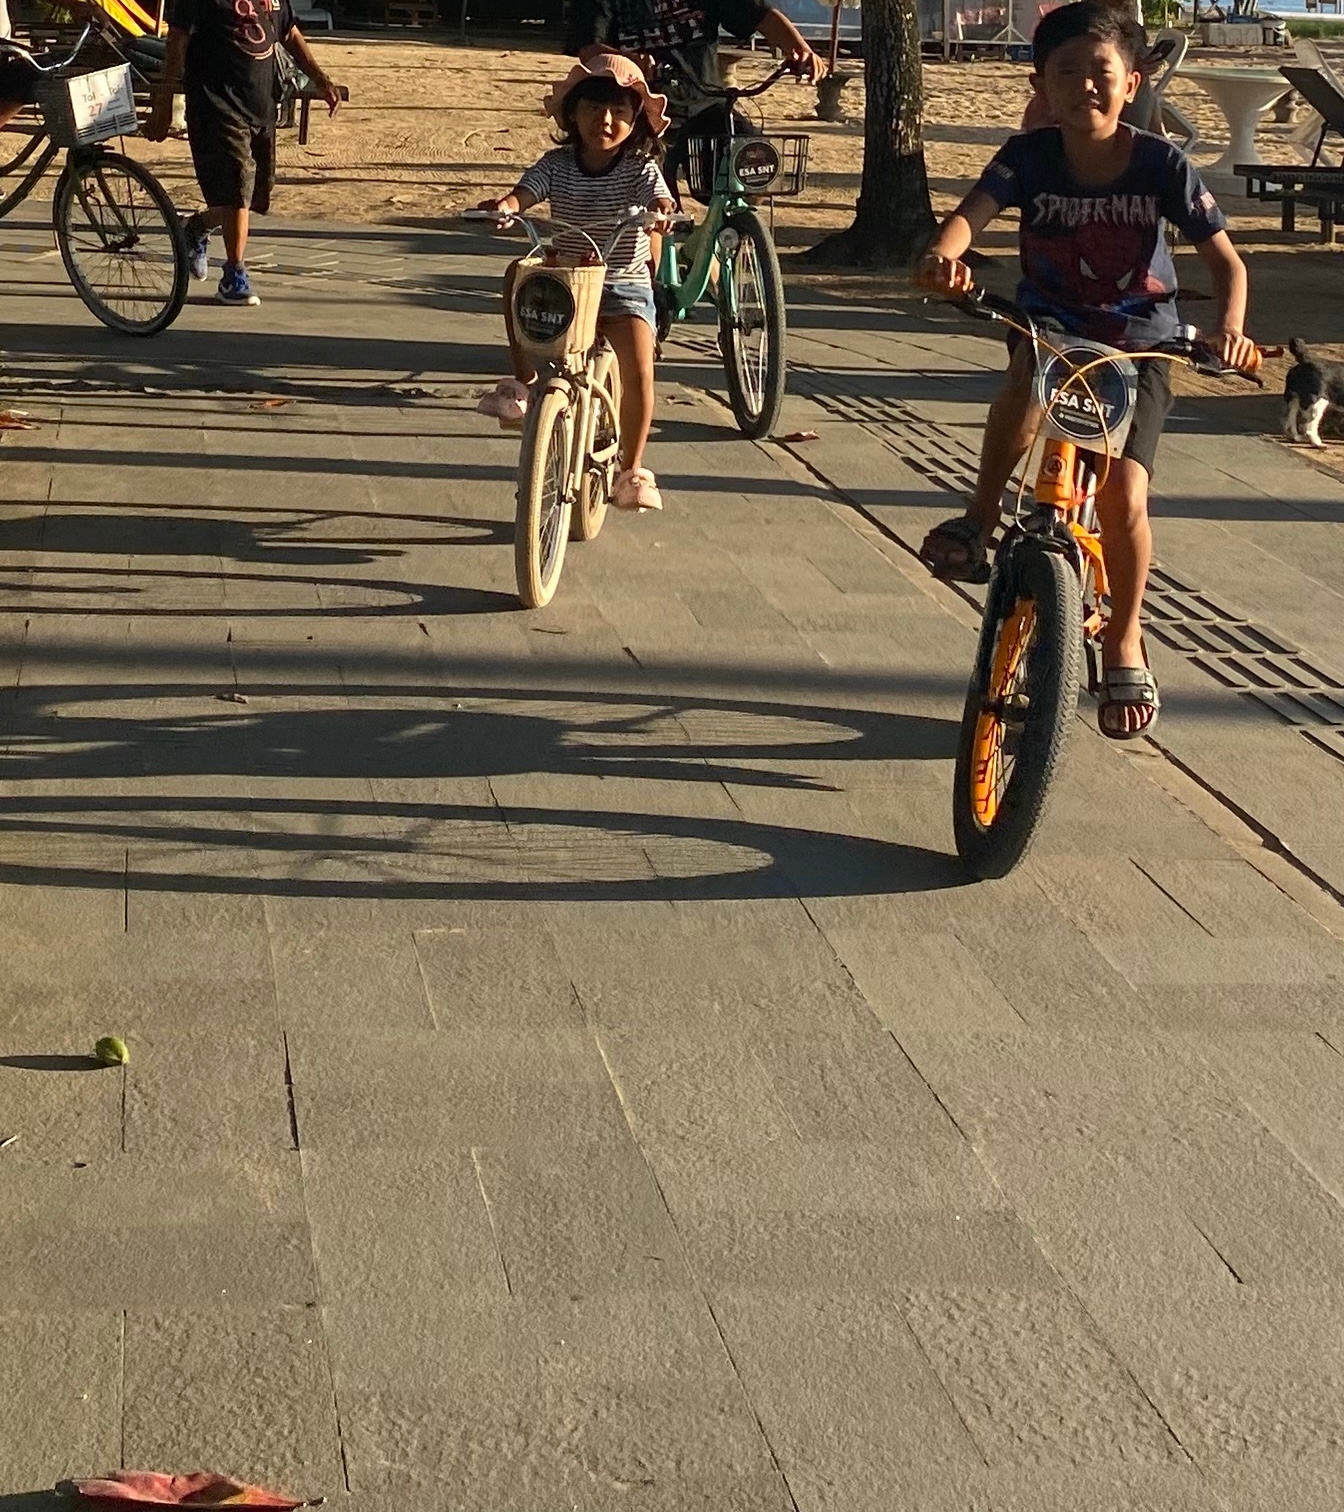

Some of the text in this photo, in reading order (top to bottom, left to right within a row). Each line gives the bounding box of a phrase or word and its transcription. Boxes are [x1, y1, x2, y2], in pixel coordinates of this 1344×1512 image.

[88, 103, 102, 117] 27
[739, 164, 775, 177] ESA SNT
[1032, 192, 1158, 228] SPIDER-MAN
[520, 305, 565, 325] ESA SNT
